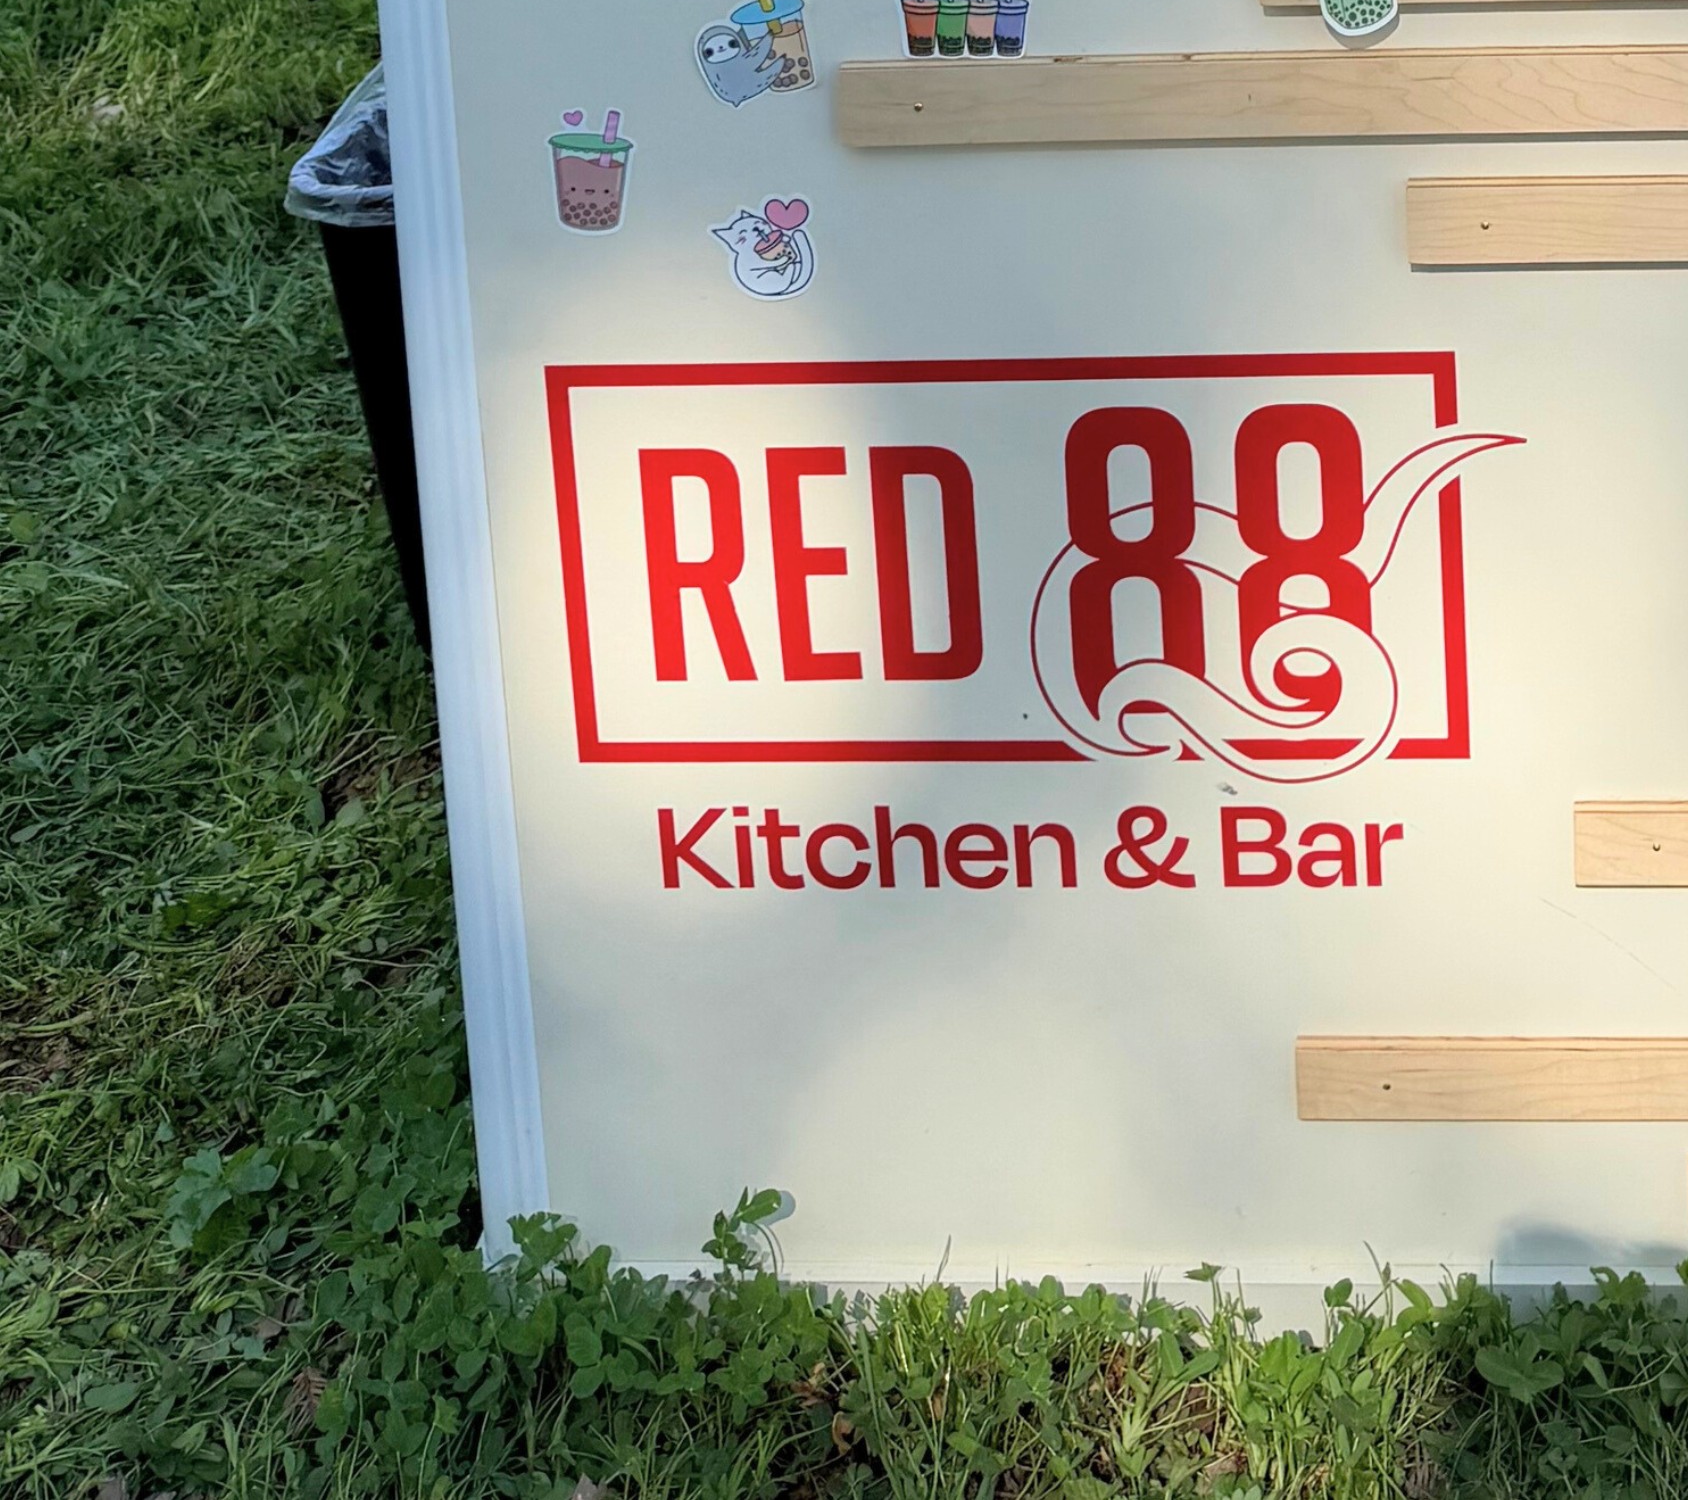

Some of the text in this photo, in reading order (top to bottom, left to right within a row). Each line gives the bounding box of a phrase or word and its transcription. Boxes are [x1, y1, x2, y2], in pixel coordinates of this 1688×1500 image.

[638, 404, 1372, 722] RED 88
[658, 805, 1405, 890] Kitchen & Bar
